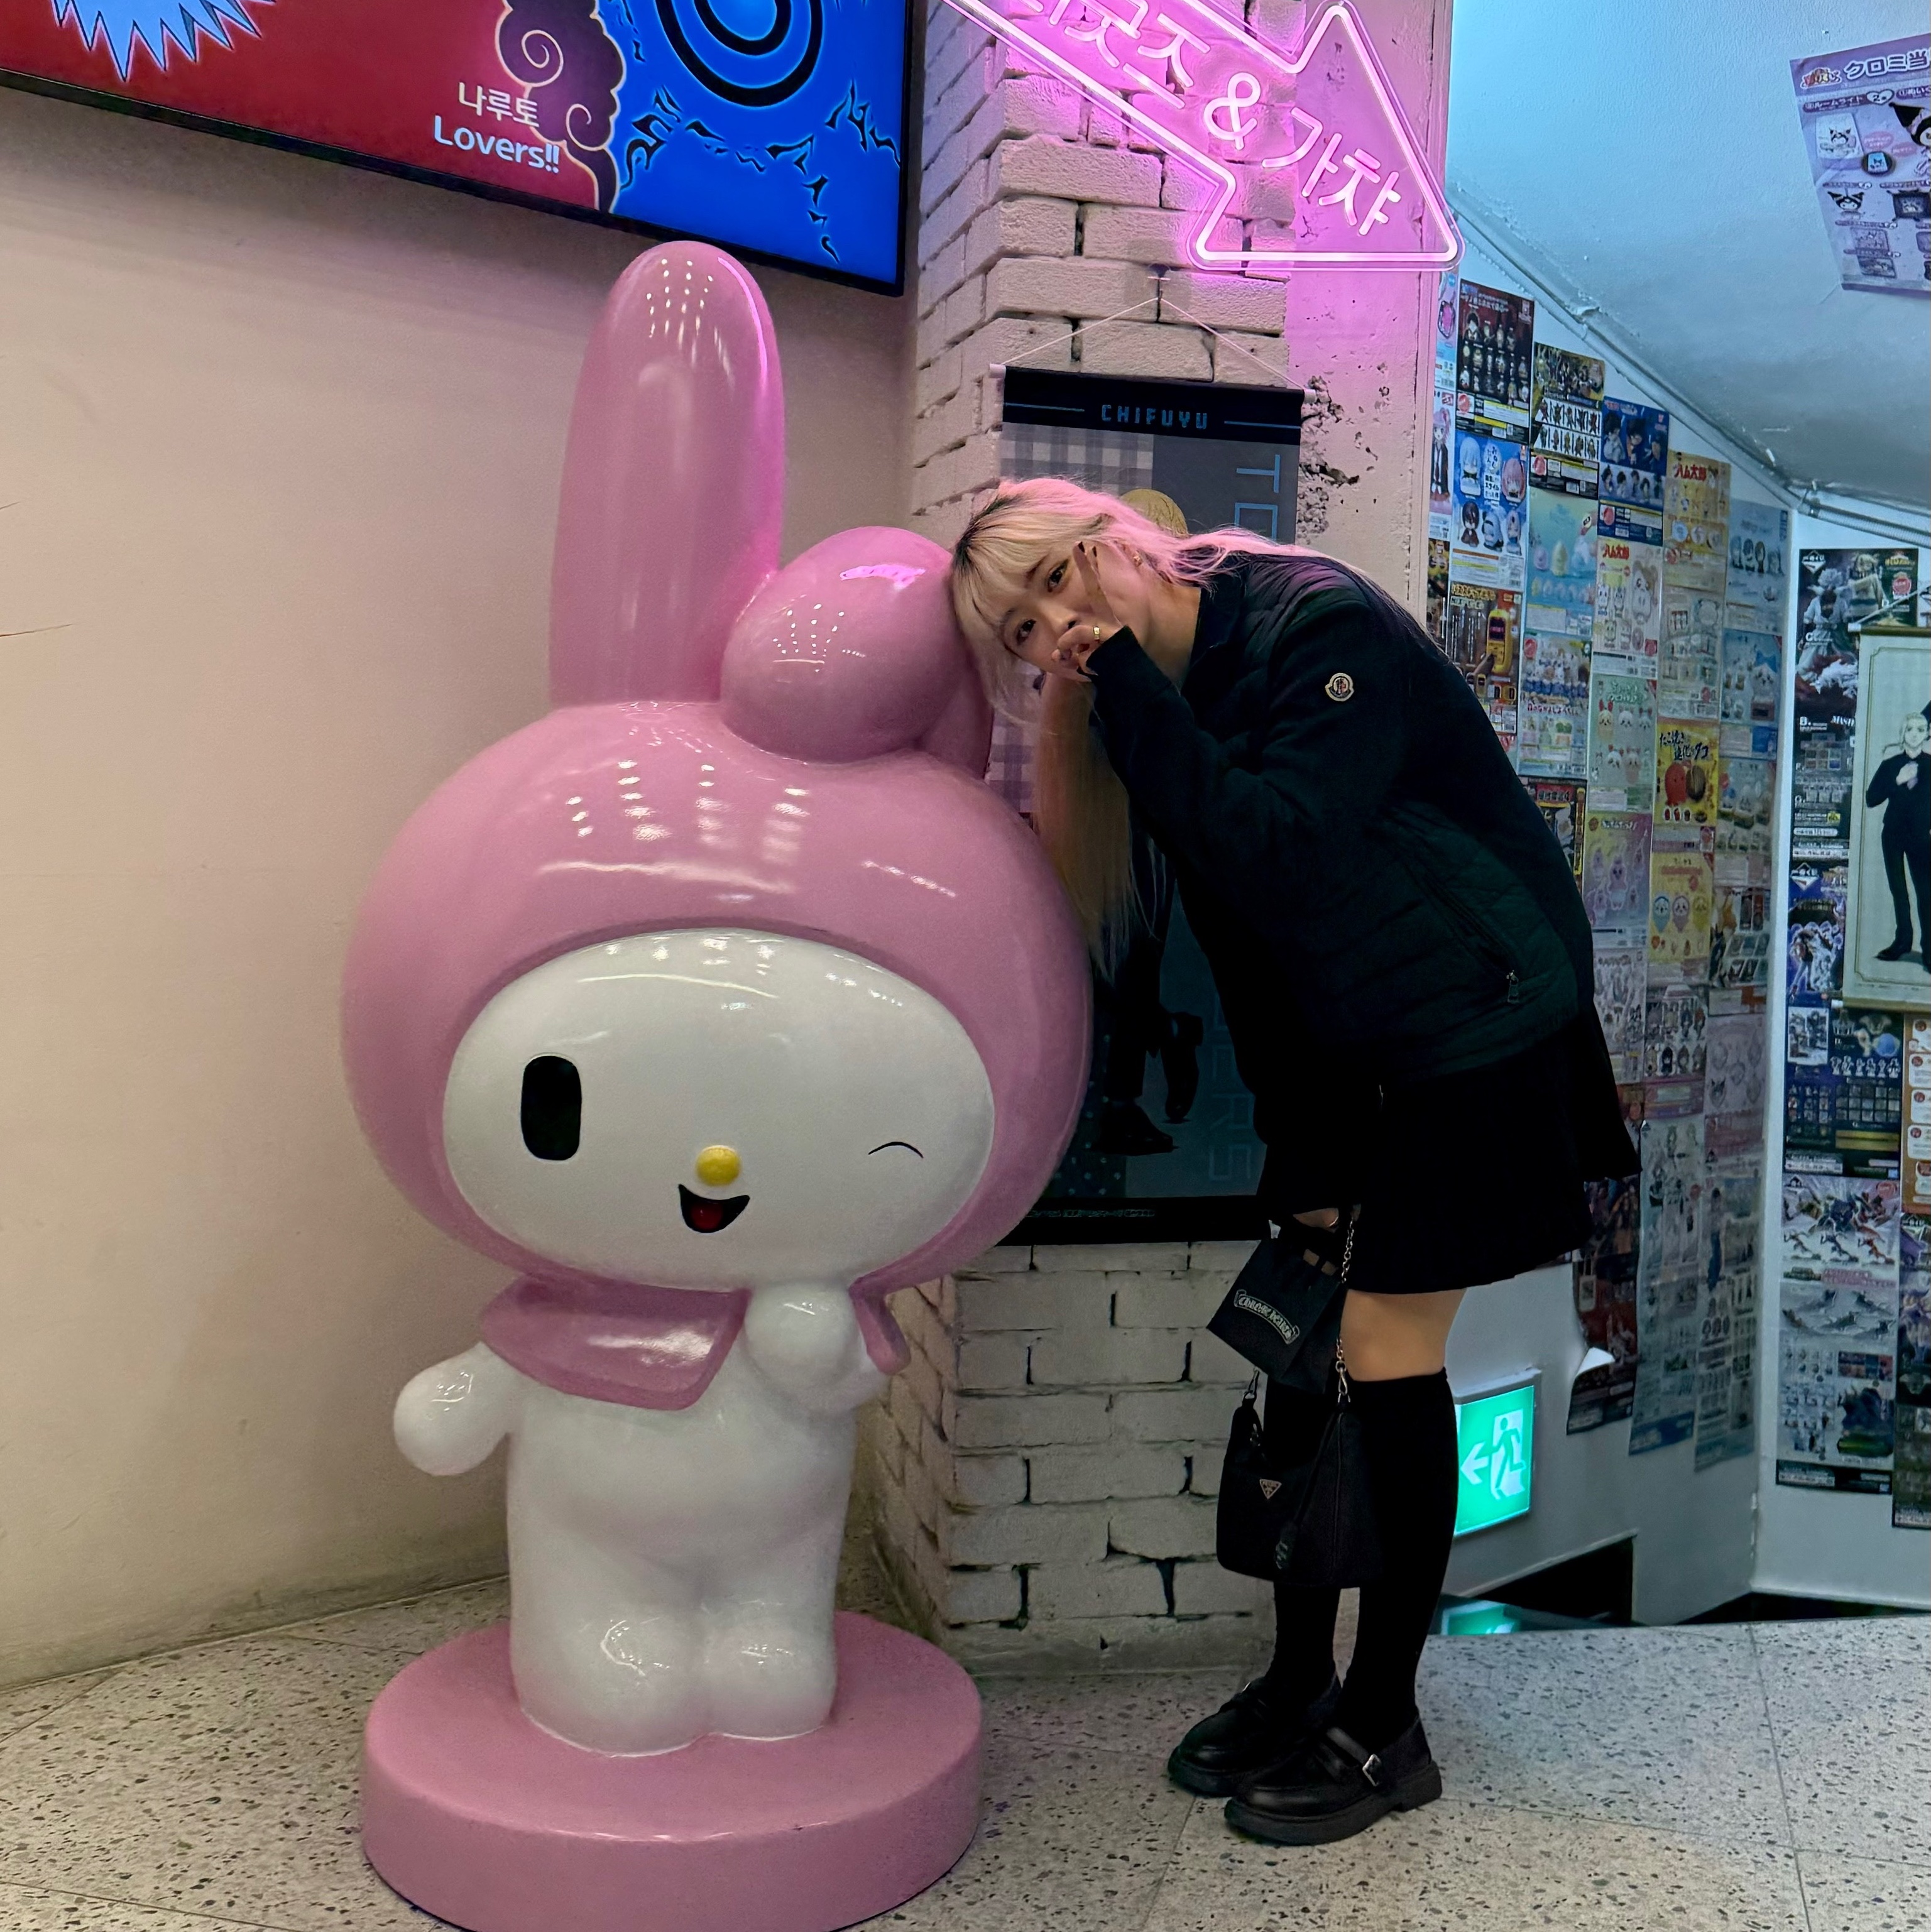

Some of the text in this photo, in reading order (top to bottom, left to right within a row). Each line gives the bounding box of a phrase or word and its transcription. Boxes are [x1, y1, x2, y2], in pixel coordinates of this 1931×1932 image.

[1844, 50, 1931, 80] クロミ当
[459, 82, 539, 128] 나루토
[434, 116, 560, 173] Lovers!!
[1204, 72, 1261, 151] &
[1262, 107, 1401, 236] 가챠
[1102, 404, 1207, 430] CHIFUYU
